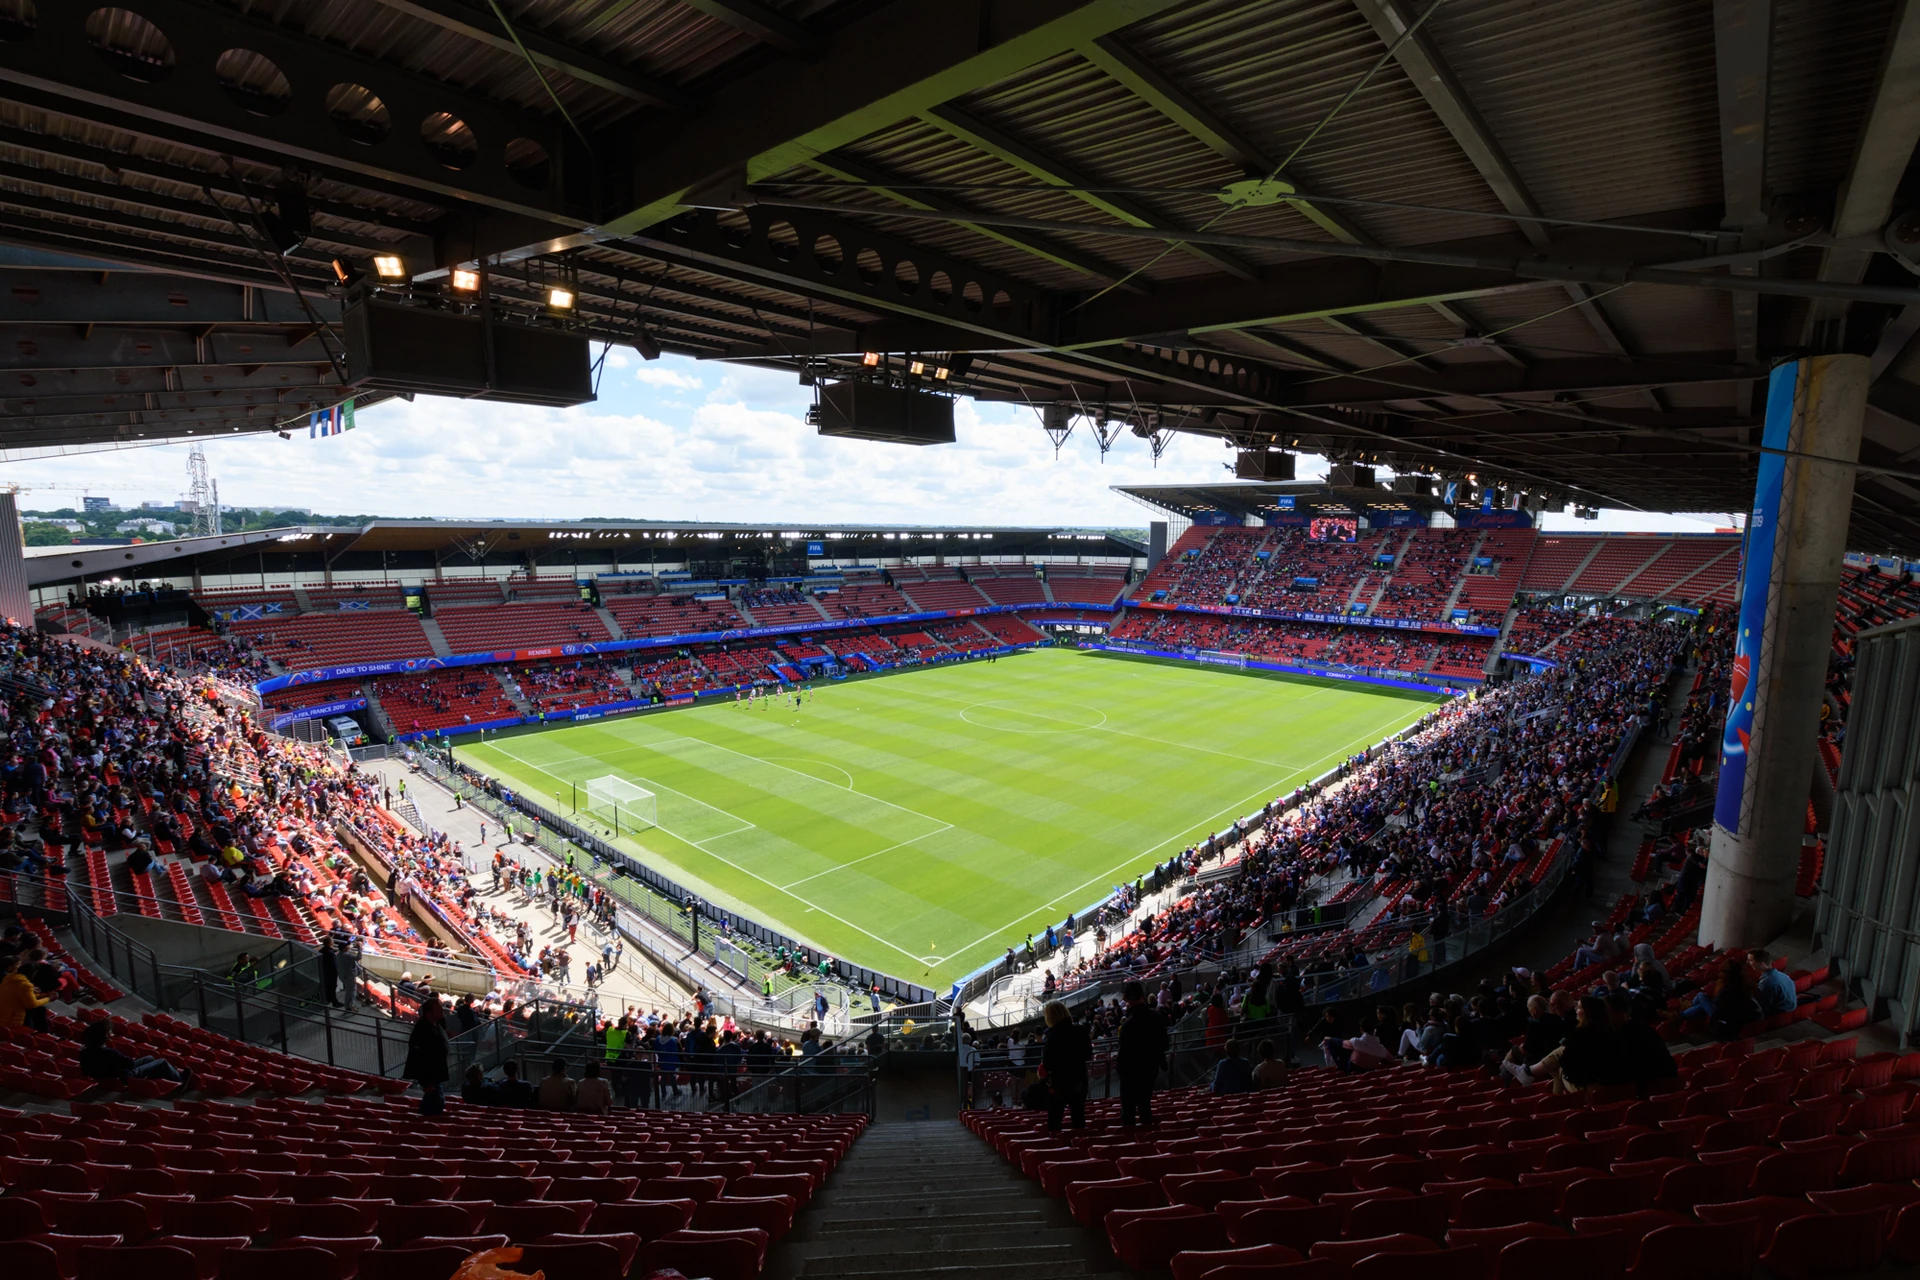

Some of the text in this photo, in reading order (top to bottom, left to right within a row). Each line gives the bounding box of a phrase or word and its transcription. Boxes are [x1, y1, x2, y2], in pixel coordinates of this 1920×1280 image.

[336, 664, 391, 675] DARE TO SHINE
[310, 706, 332, 716] FRANCE
